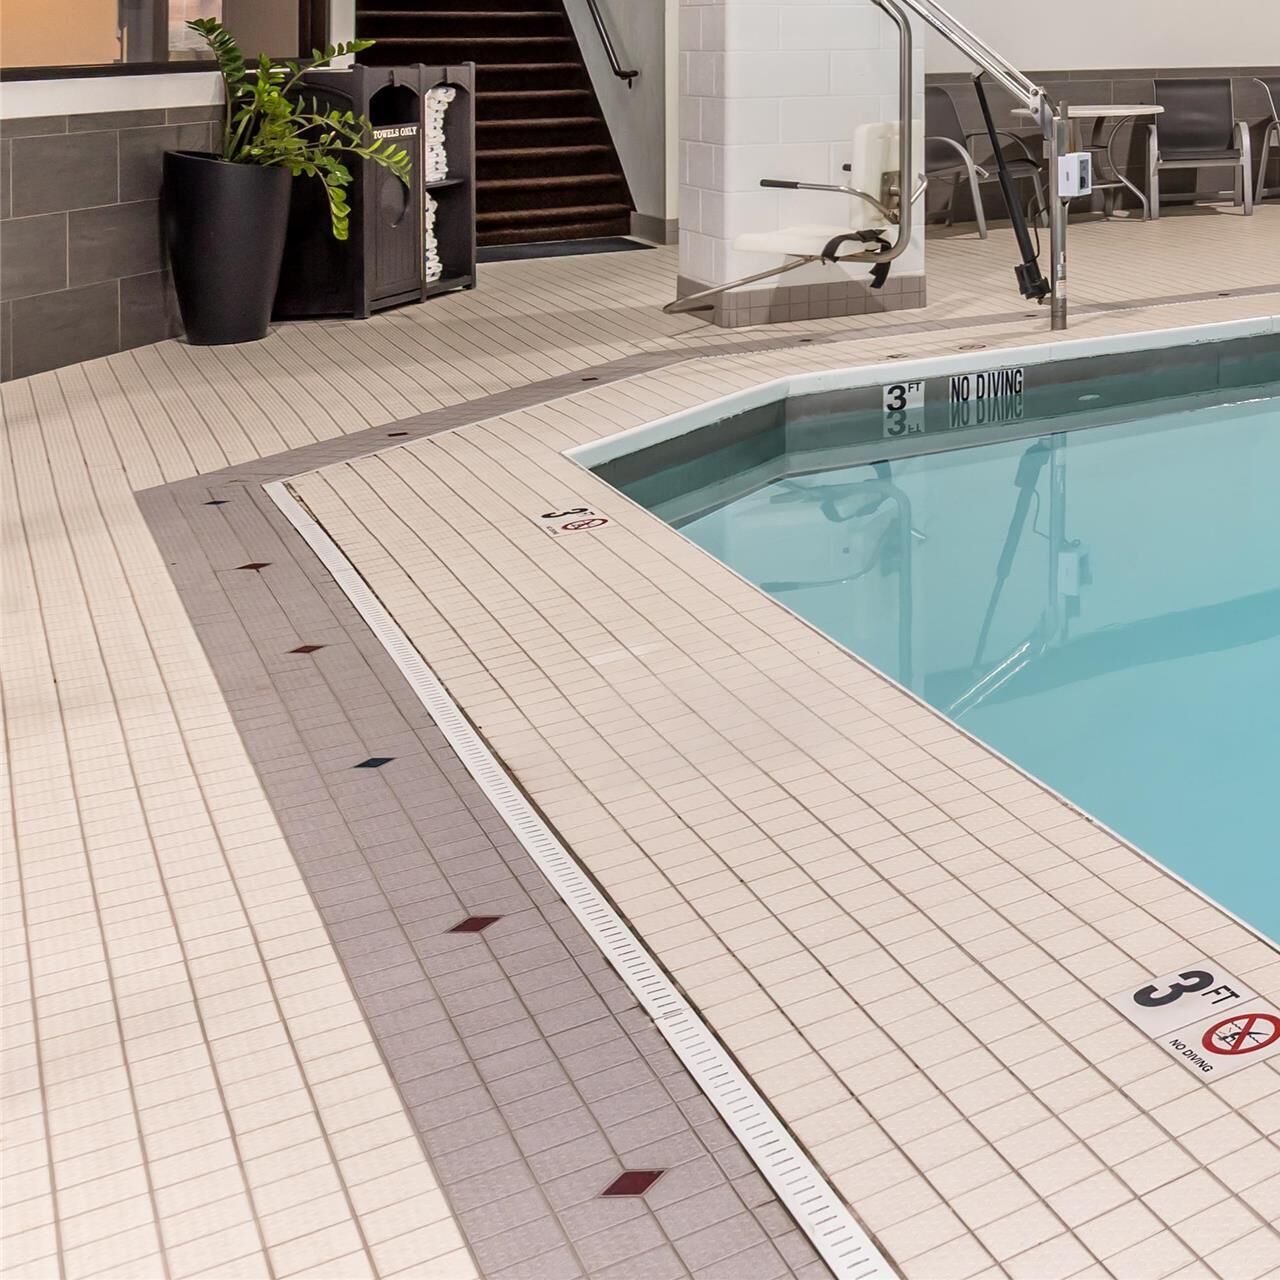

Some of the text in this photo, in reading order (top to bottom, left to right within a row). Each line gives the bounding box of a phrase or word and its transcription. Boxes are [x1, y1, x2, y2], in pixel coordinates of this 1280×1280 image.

[373, 126, 417, 139] TOWELS ONLY
[886, 382, 921, 411] 3 FT
[951, 369, 1023, 402] NO DIVING
[1133, 970, 1240, 1008] 3 FT
[1169, 1039, 1213, 1073] NO DIVING
